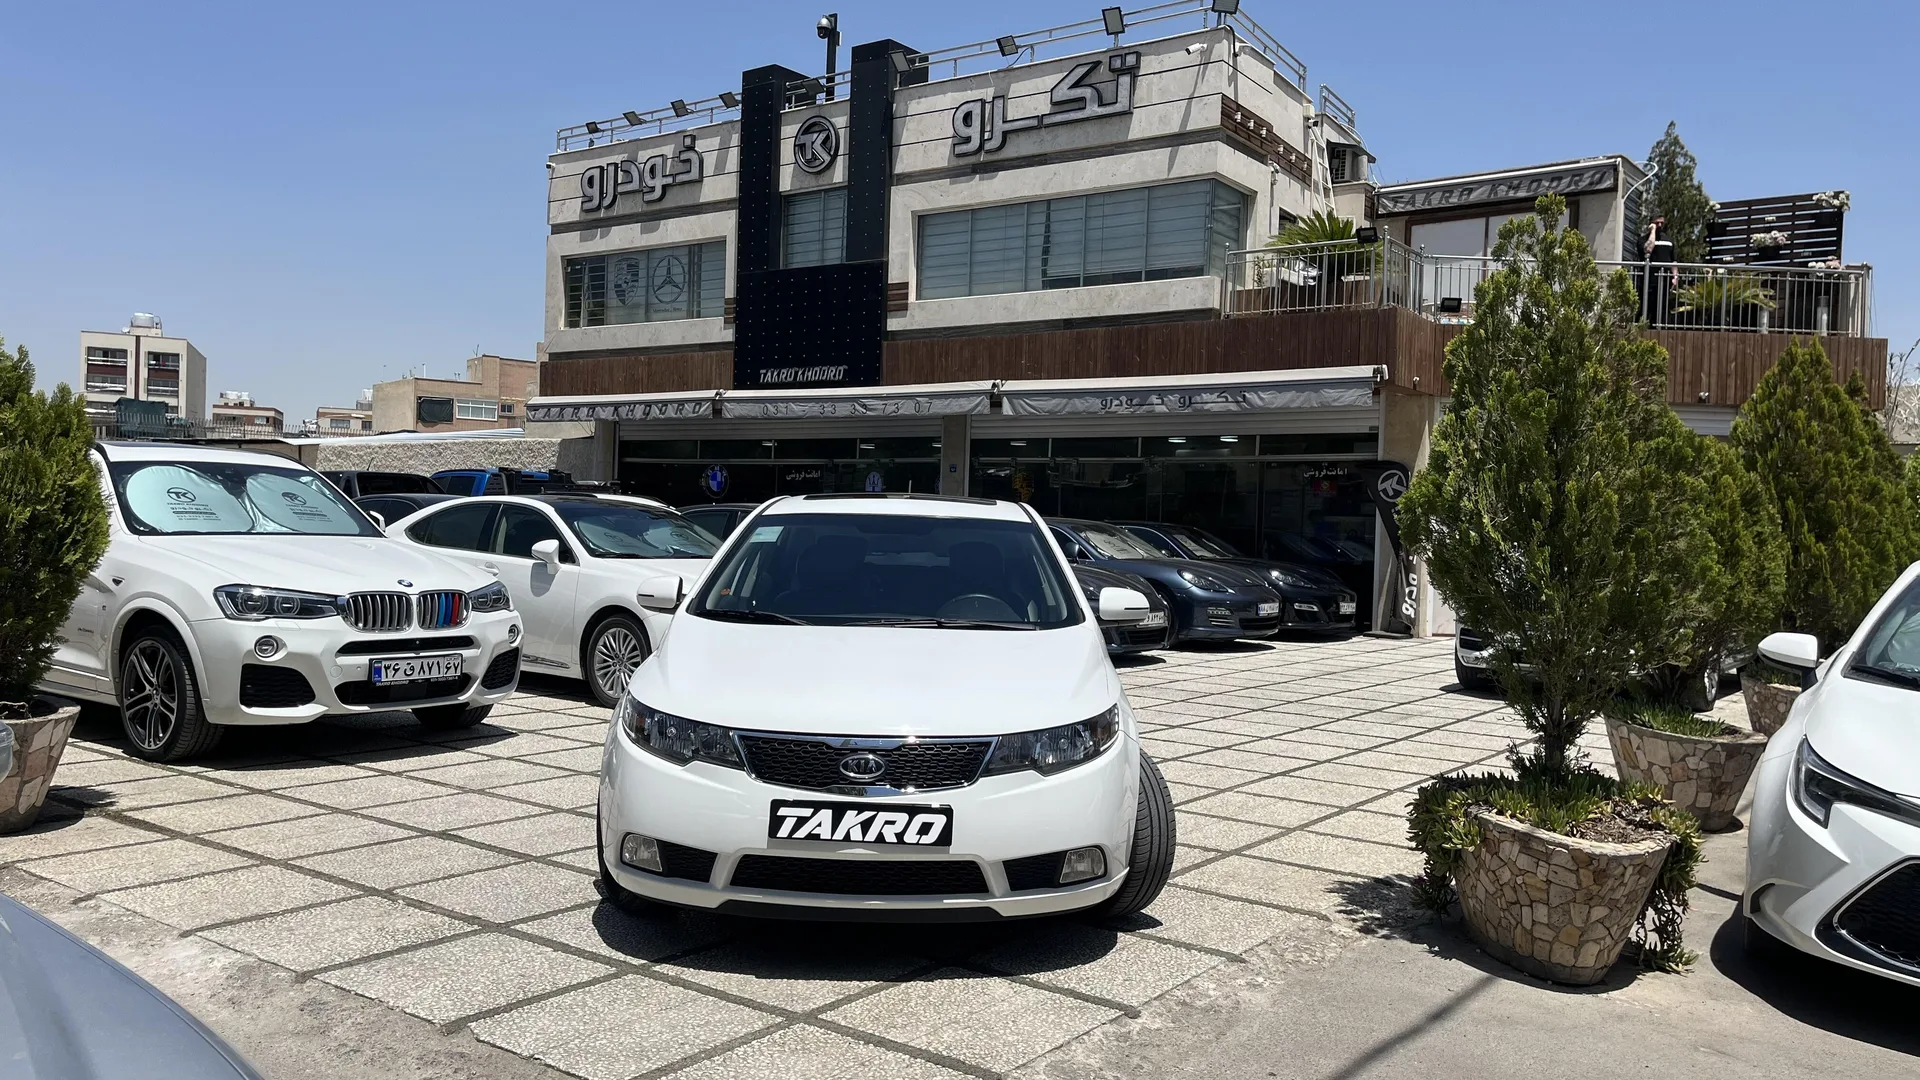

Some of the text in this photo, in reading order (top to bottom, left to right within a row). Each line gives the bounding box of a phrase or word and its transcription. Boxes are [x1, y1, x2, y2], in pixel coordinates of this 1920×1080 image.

[952, 51, 1141, 157] تکرو
[580, 134, 703, 213] خودرو
[1392, 187, 1473, 210] TAKRO
[760, 368, 796, 383] TAKRO
[532, 406, 595, 420] TAKRO
[762, 403, 789, 416] 031
[819, 403, 837, 416] 33
[881, 403, 900, 415] 73
[914, 402, 933, 414] 07
[847, 759, 877, 773] KIA
[776, 806, 948, 845] TAKRO
